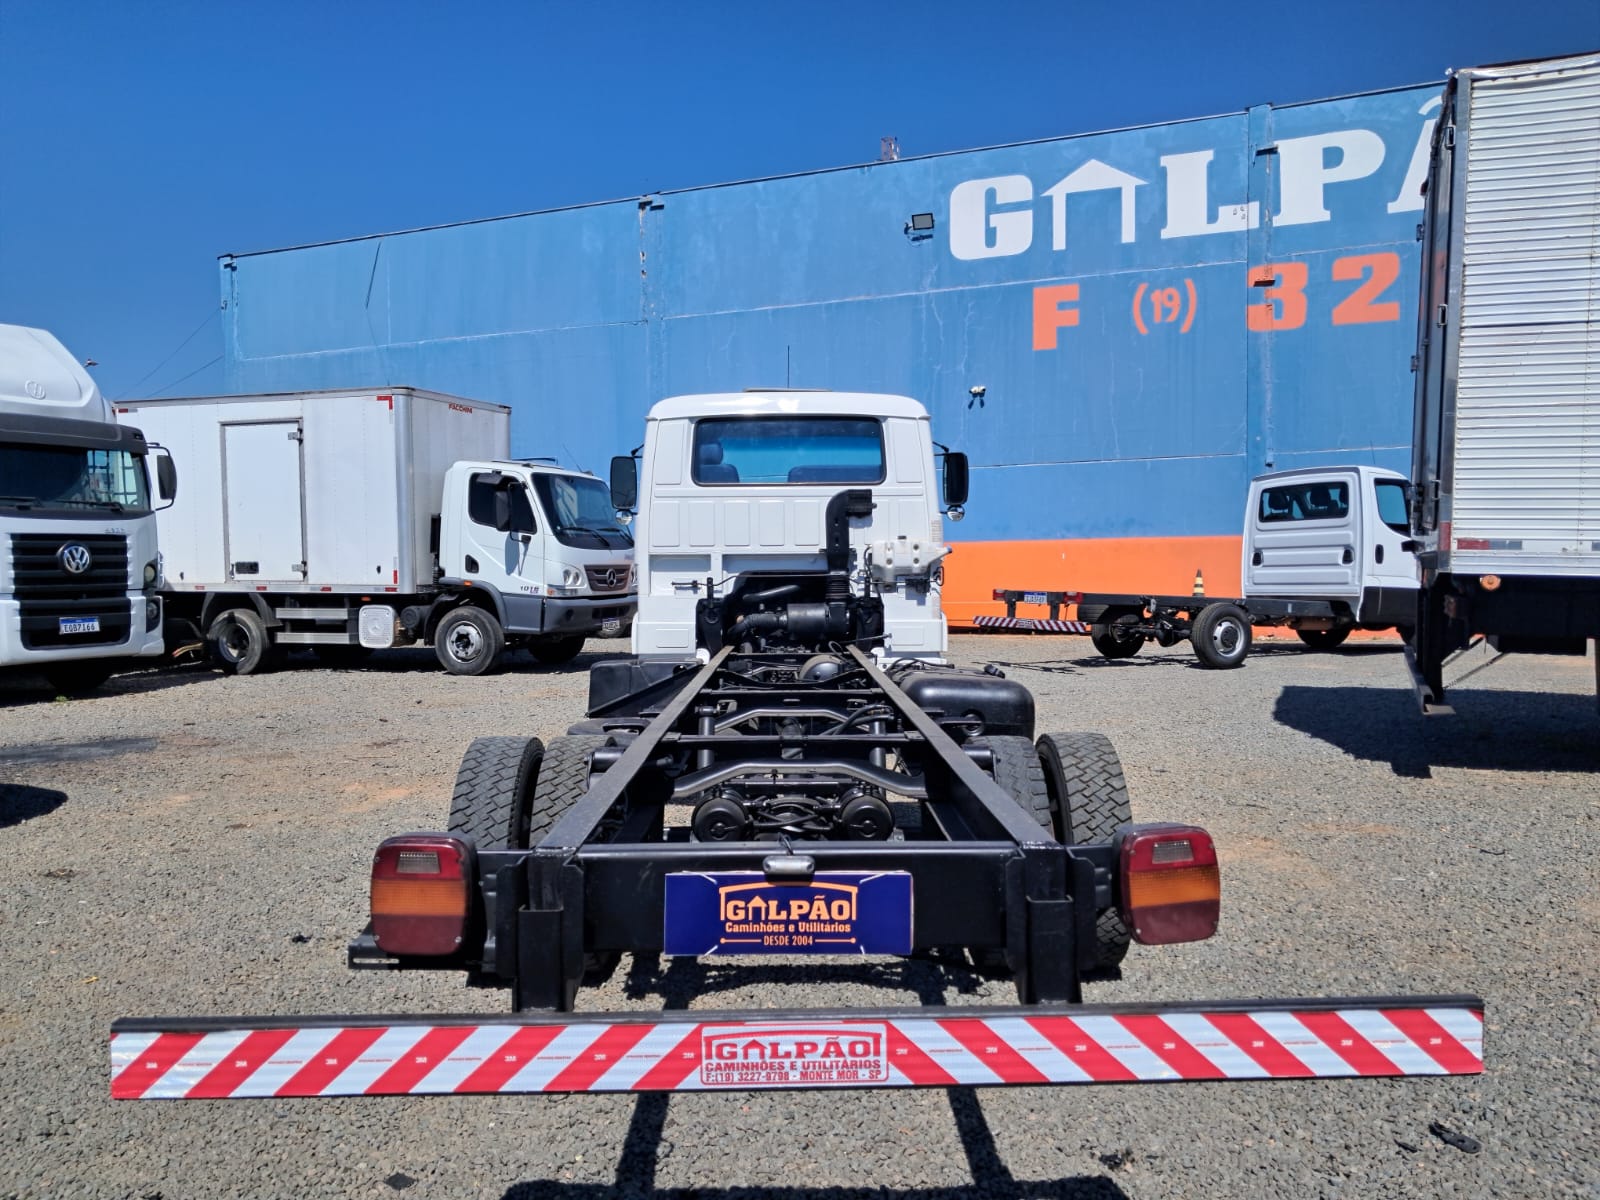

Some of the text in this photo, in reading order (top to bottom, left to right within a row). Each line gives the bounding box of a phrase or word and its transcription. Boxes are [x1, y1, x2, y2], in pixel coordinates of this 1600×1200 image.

[1032, 284, 1080, 351] F
[1133, 277, 1197, 334] (19)
[725, 921, 851, 933] Caminhões e Utilitários
[763, 935, 814, 946] DESDE 2004
[705, 1058, 881, 1073] CAMINHÕES E UTILITÁRIOS
[799, 1070, 834, 1081] MONTE
[836, 1069, 859, 1080] MOR
[868, 1068, 882, 1079] SP
